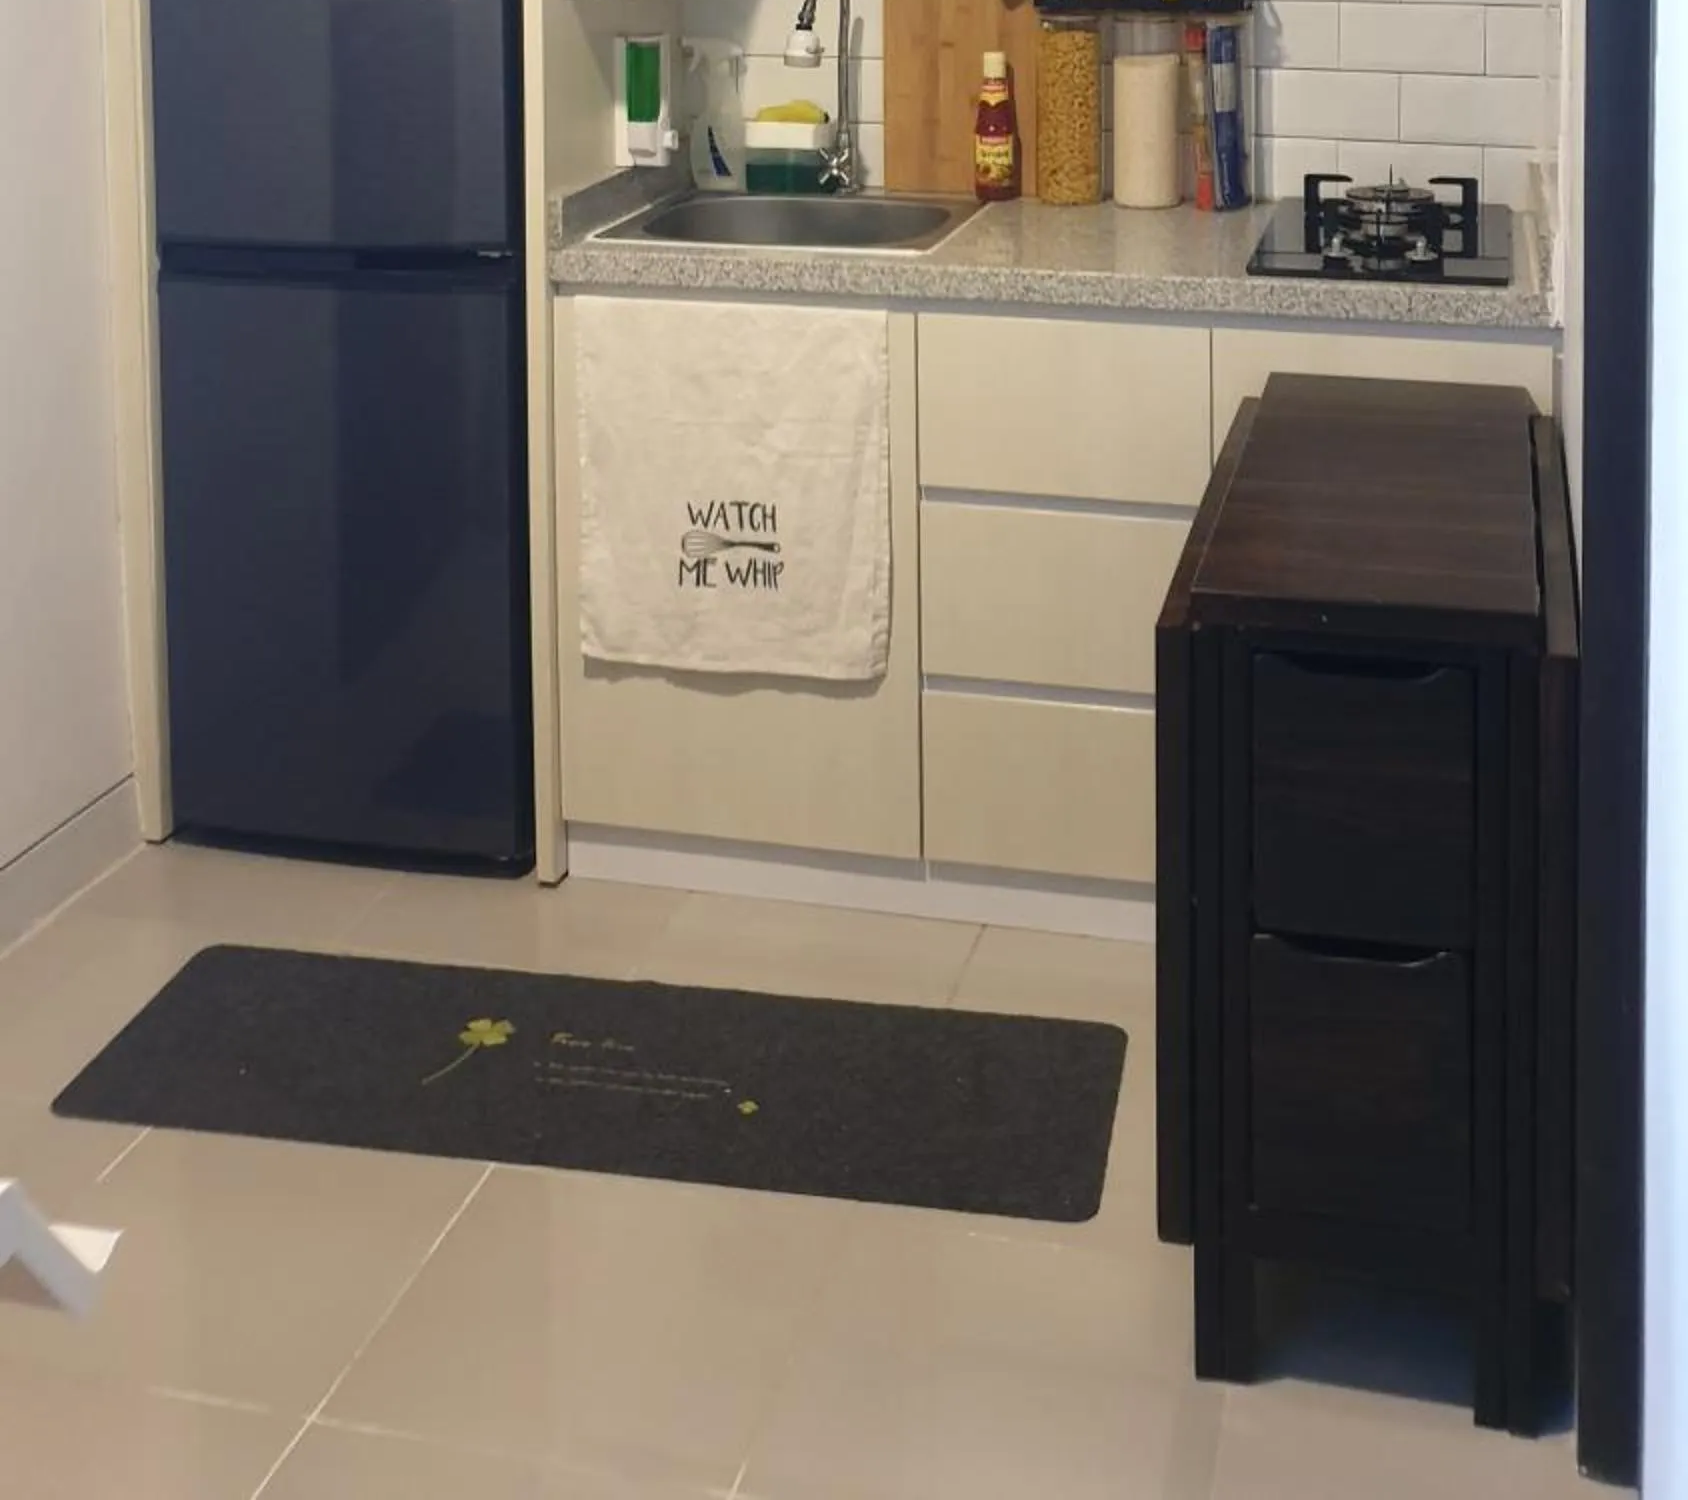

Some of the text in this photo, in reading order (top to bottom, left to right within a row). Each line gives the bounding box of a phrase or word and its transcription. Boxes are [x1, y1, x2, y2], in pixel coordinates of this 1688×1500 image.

[687, 500, 777, 532] WATCH
[678, 557, 784, 591] ME WHIP
